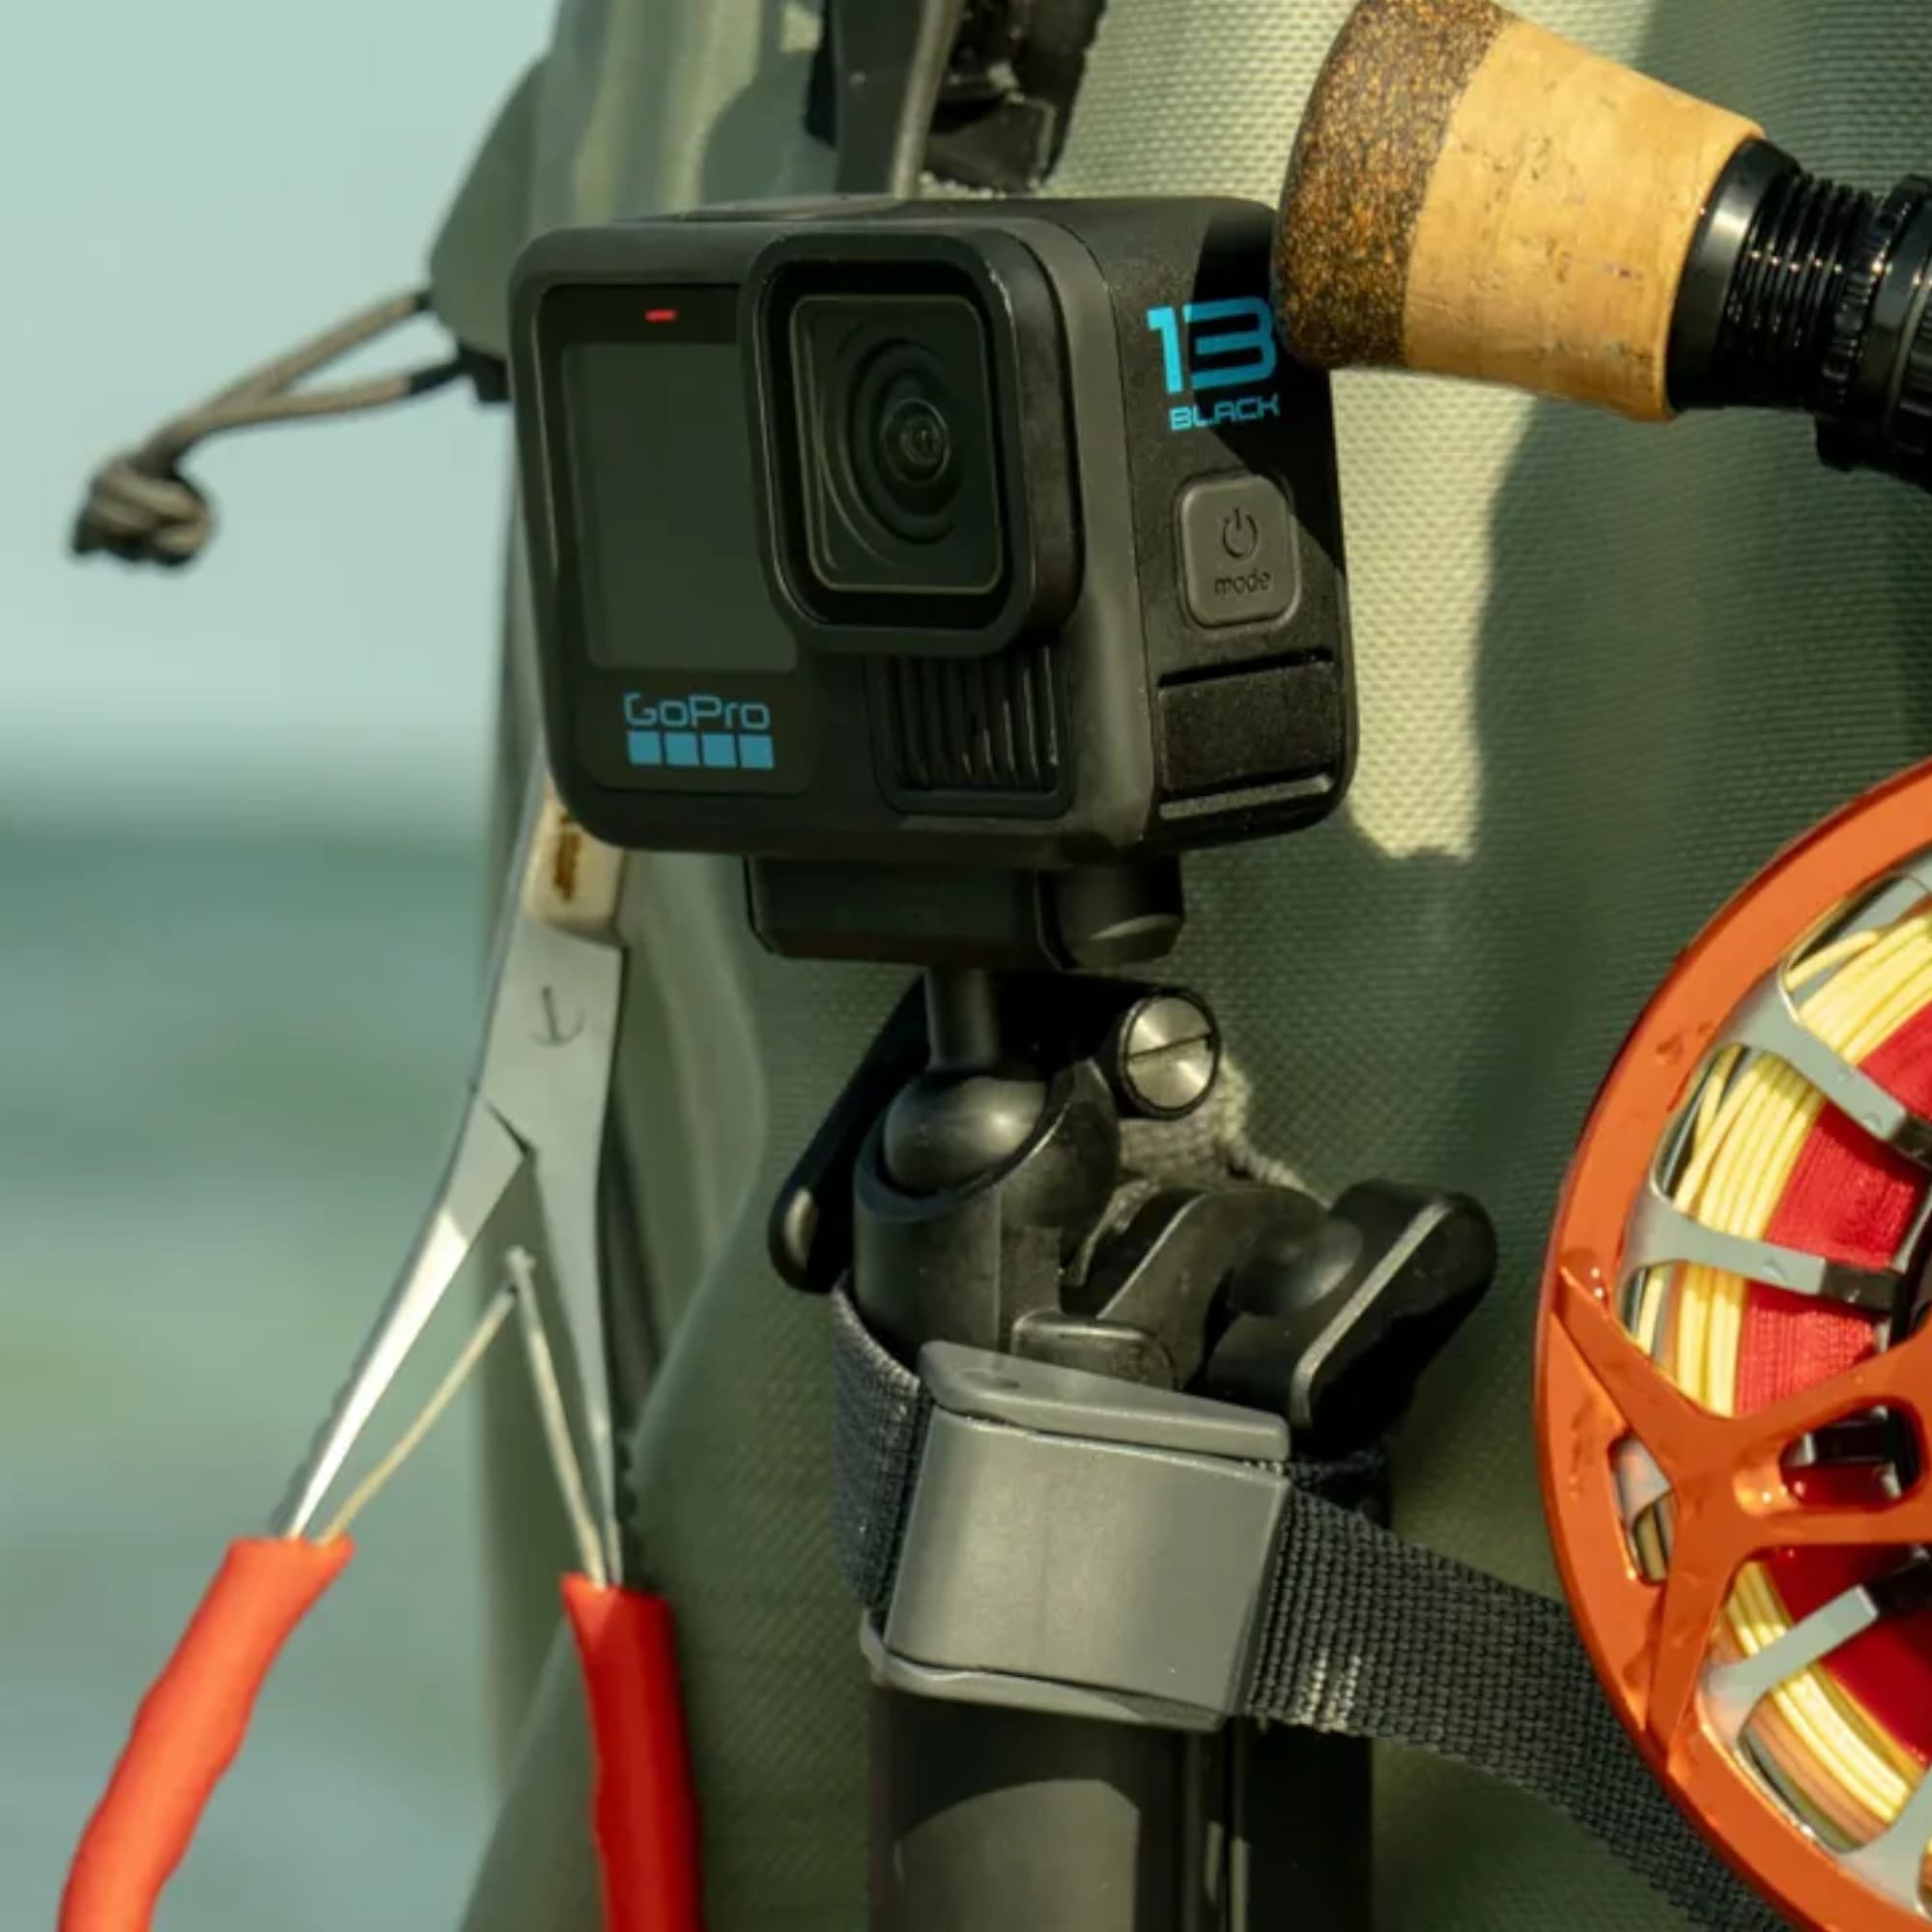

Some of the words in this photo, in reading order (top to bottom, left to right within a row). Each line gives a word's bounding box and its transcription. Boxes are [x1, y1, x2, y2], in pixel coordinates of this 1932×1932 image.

[1147, 296, 1277, 394] 13
[1169, 393, 1280, 431] BLACK
[1214, 572, 1271, 596] mode
[623, 692, 770, 730] GoPro
